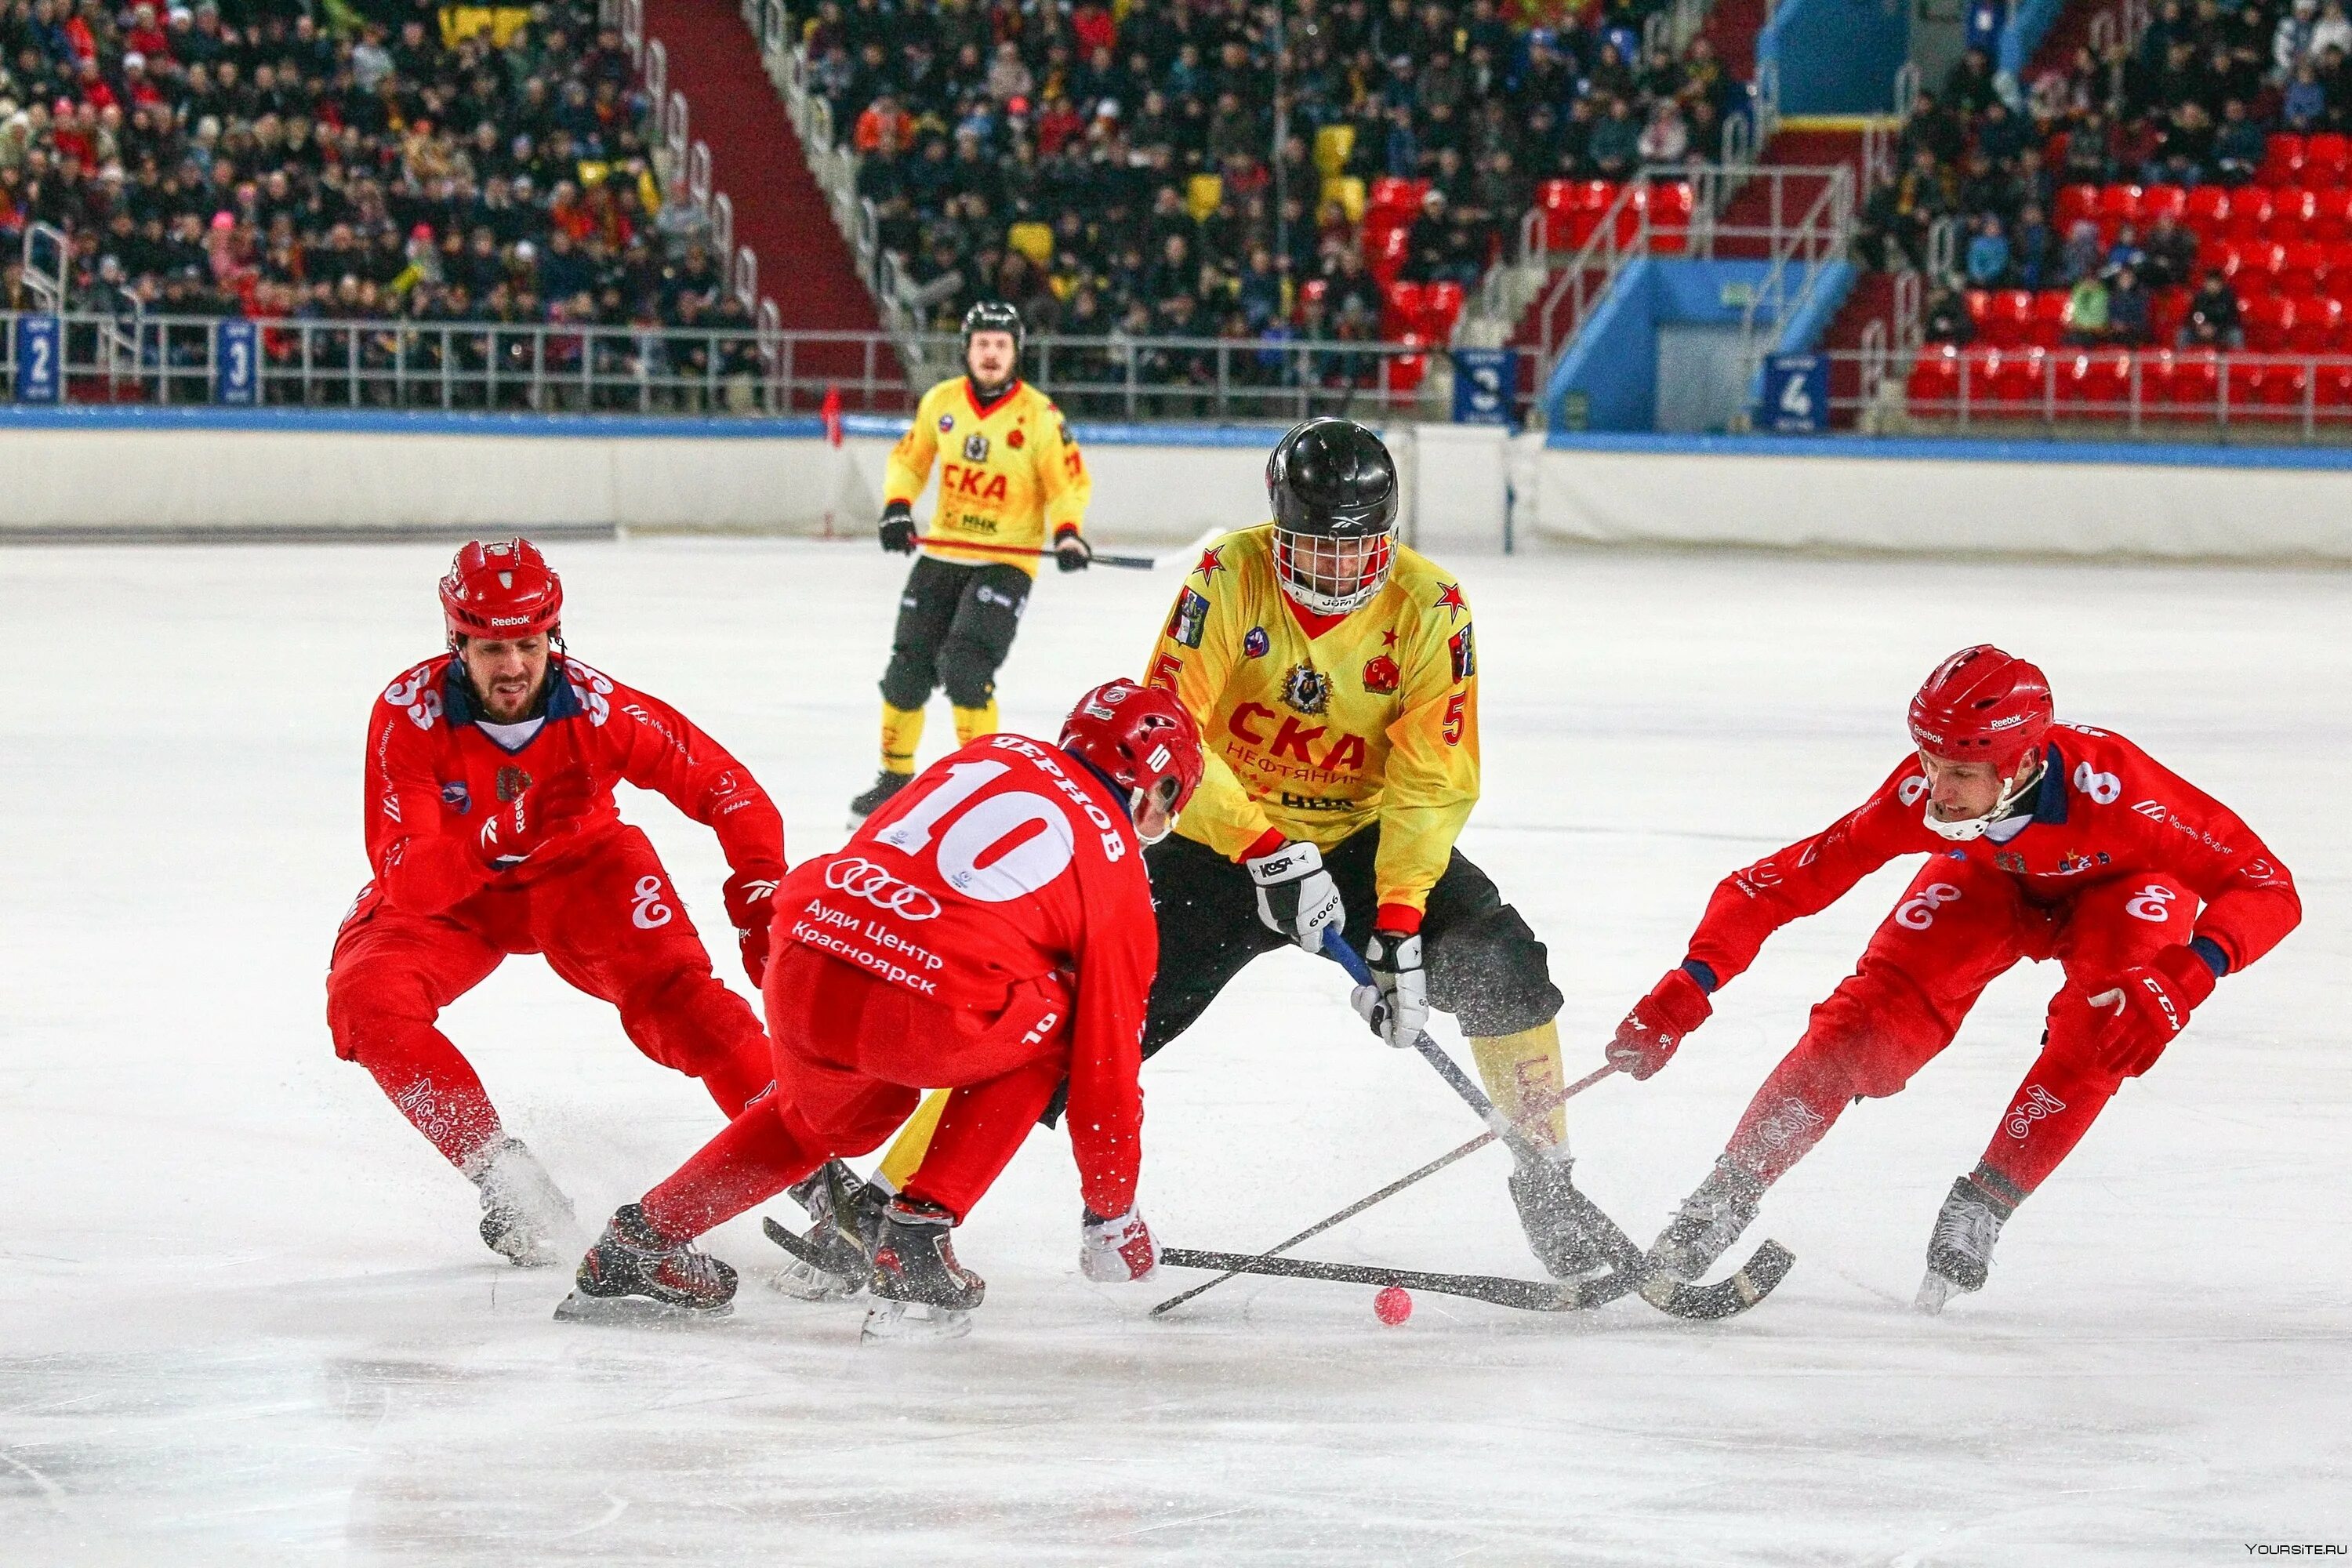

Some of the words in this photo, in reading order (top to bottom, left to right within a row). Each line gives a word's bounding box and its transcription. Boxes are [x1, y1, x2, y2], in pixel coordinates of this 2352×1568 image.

[31, 336, 49, 382] 2
[229, 341, 249, 386] 3
[1472, 368, 1499, 410] 3
[1779, 375, 1811, 416] 4
[943, 464, 1007, 501] СКА
[491, 615, 530, 627] Reebok
[1228, 702, 1366, 771] СКА
[1442, 691, 1467, 747] 5
[1914, 723, 1944, 745] Reebok
[1991, 713, 2022, 728] Reebok
[1145, 743, 1171, 773] 10
[2073, 760, 2122, 805] 8
[873, 758, 1075, 903] 10
[1308, 894, 1339, 928] 6066
[804, 898, 862, 932] Ауди
[864, 920, 944, 972] Центр
[792, 920, 938, 996] Красноярск
[2142, 976, 2182, 1031] CCM
[1021, 1012, 1058, 1044] 10
